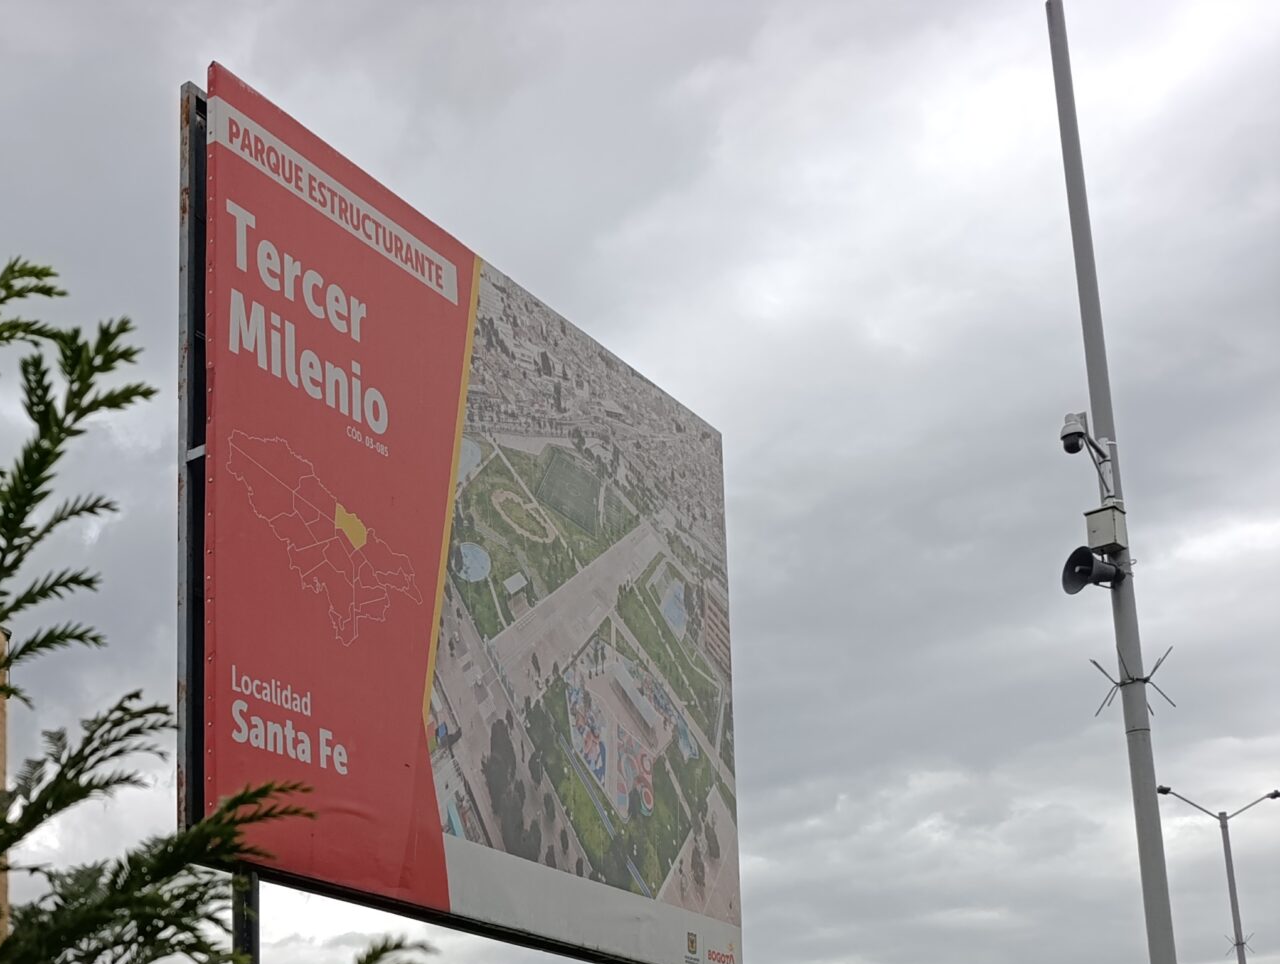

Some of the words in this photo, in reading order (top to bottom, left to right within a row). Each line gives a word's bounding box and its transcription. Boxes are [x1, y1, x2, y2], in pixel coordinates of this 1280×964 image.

[226, 199, 365, 342] Tercer
[228, 116, 304, 193] PARQUE
[308, 173, 443, 291] ESTRUCTURANTE
[228, 288, 388, 434] Milenio
[231, 664, 311, 716] Localidad
[231, 699, 311, 764] Santa
[319, 727, 348, 775] Fe
